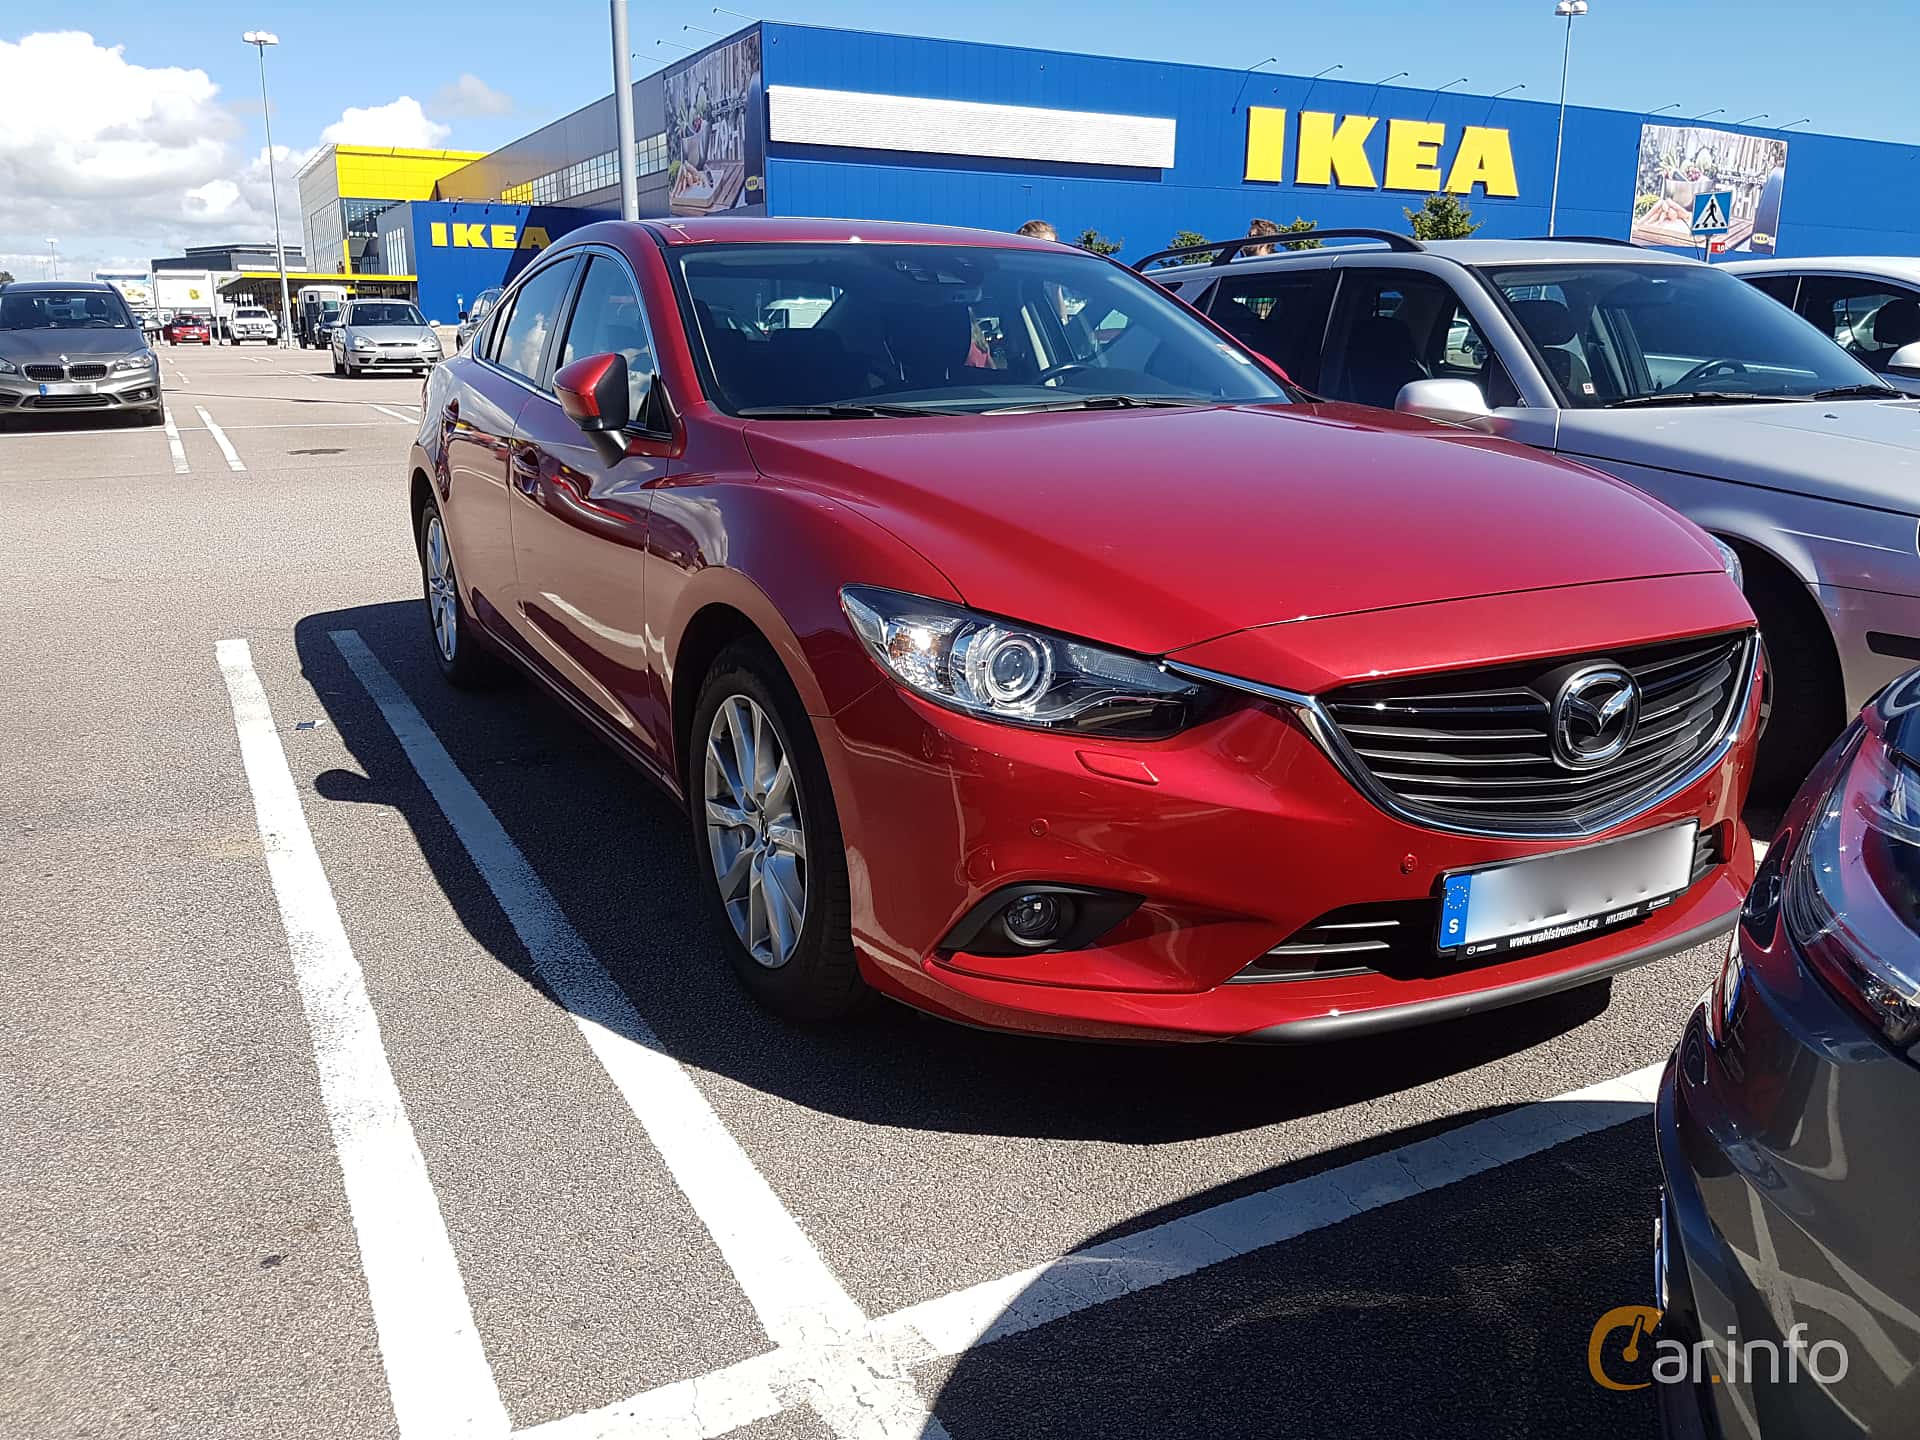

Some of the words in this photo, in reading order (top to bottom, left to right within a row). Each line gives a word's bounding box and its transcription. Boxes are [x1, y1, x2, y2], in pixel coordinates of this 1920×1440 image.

[1243, 106, 1519, 197] IKEA
[431, 222, 551, 249] IKEA
[1448, 918, 1459, 934] S
